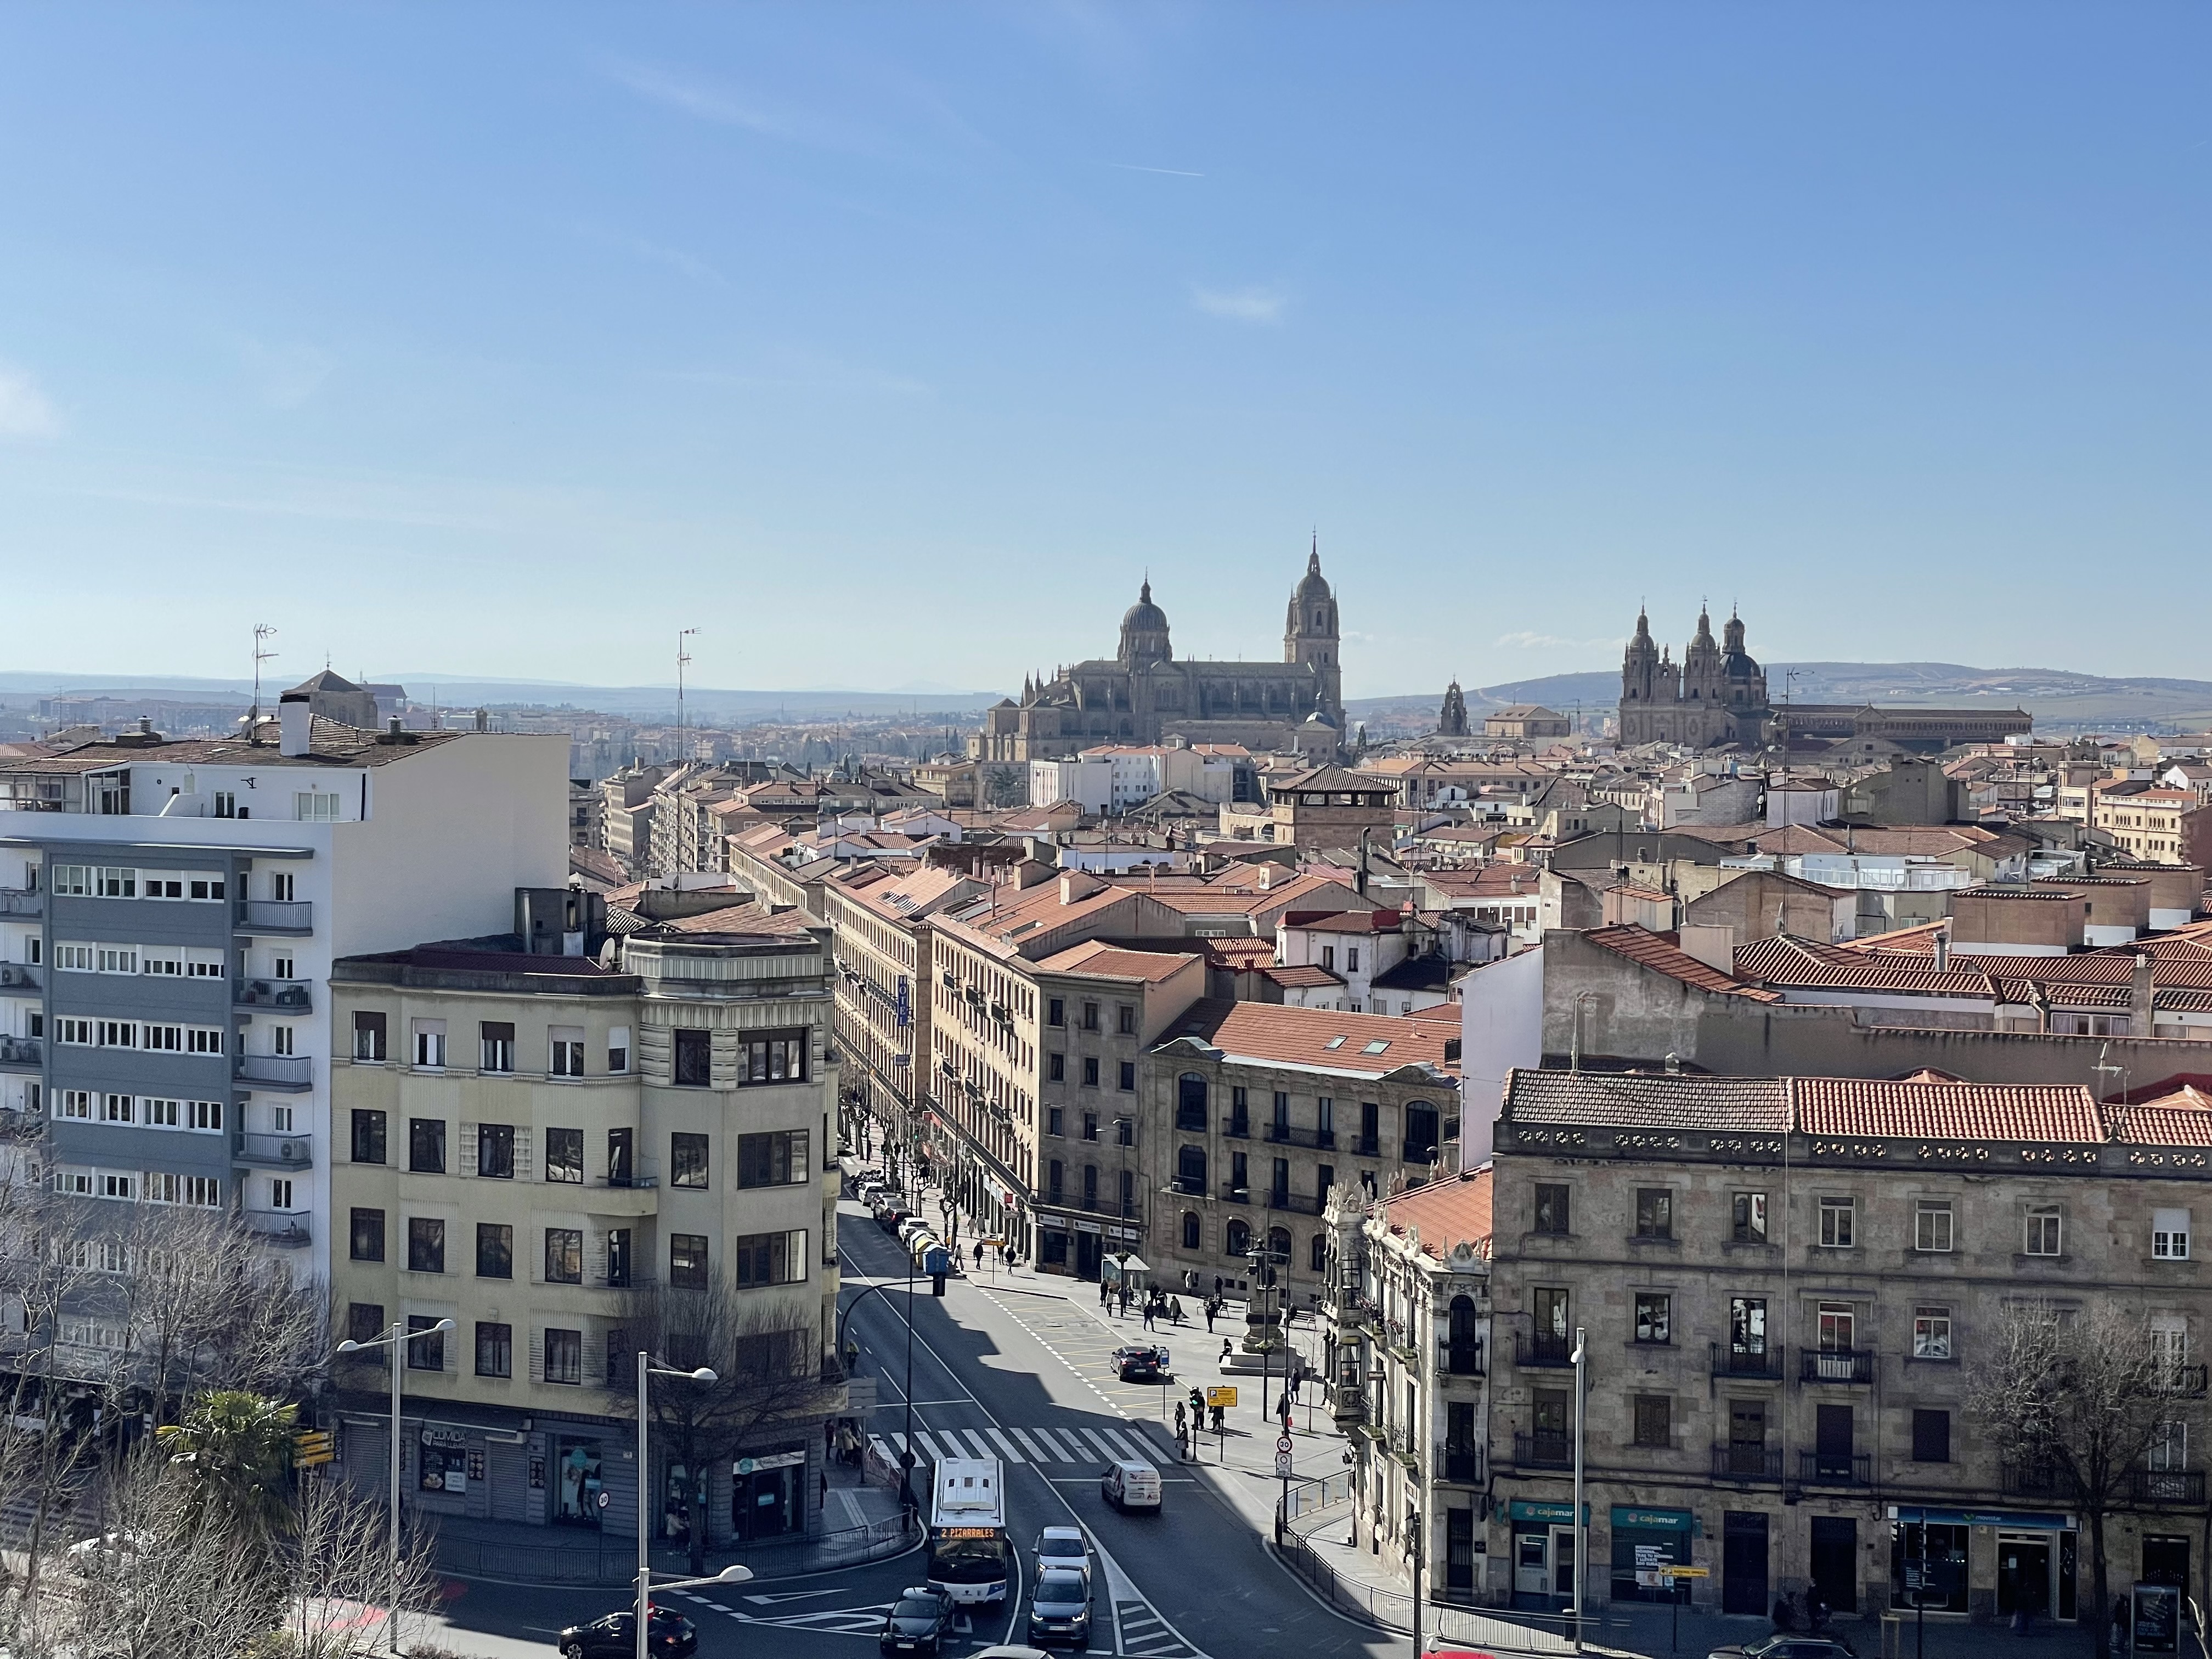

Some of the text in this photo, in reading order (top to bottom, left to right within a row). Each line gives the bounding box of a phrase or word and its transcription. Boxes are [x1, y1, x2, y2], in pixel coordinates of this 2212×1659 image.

[433, 1430, 465, 1442] COMIDA
[432, 1440, 447, 1448] PARA
[1538, 1508, 1575, 1517] cajamar
[1639, 1514, 1679, 1524] cajamar
[941, 1528, 995, 1538] 2 PIZARRALES
